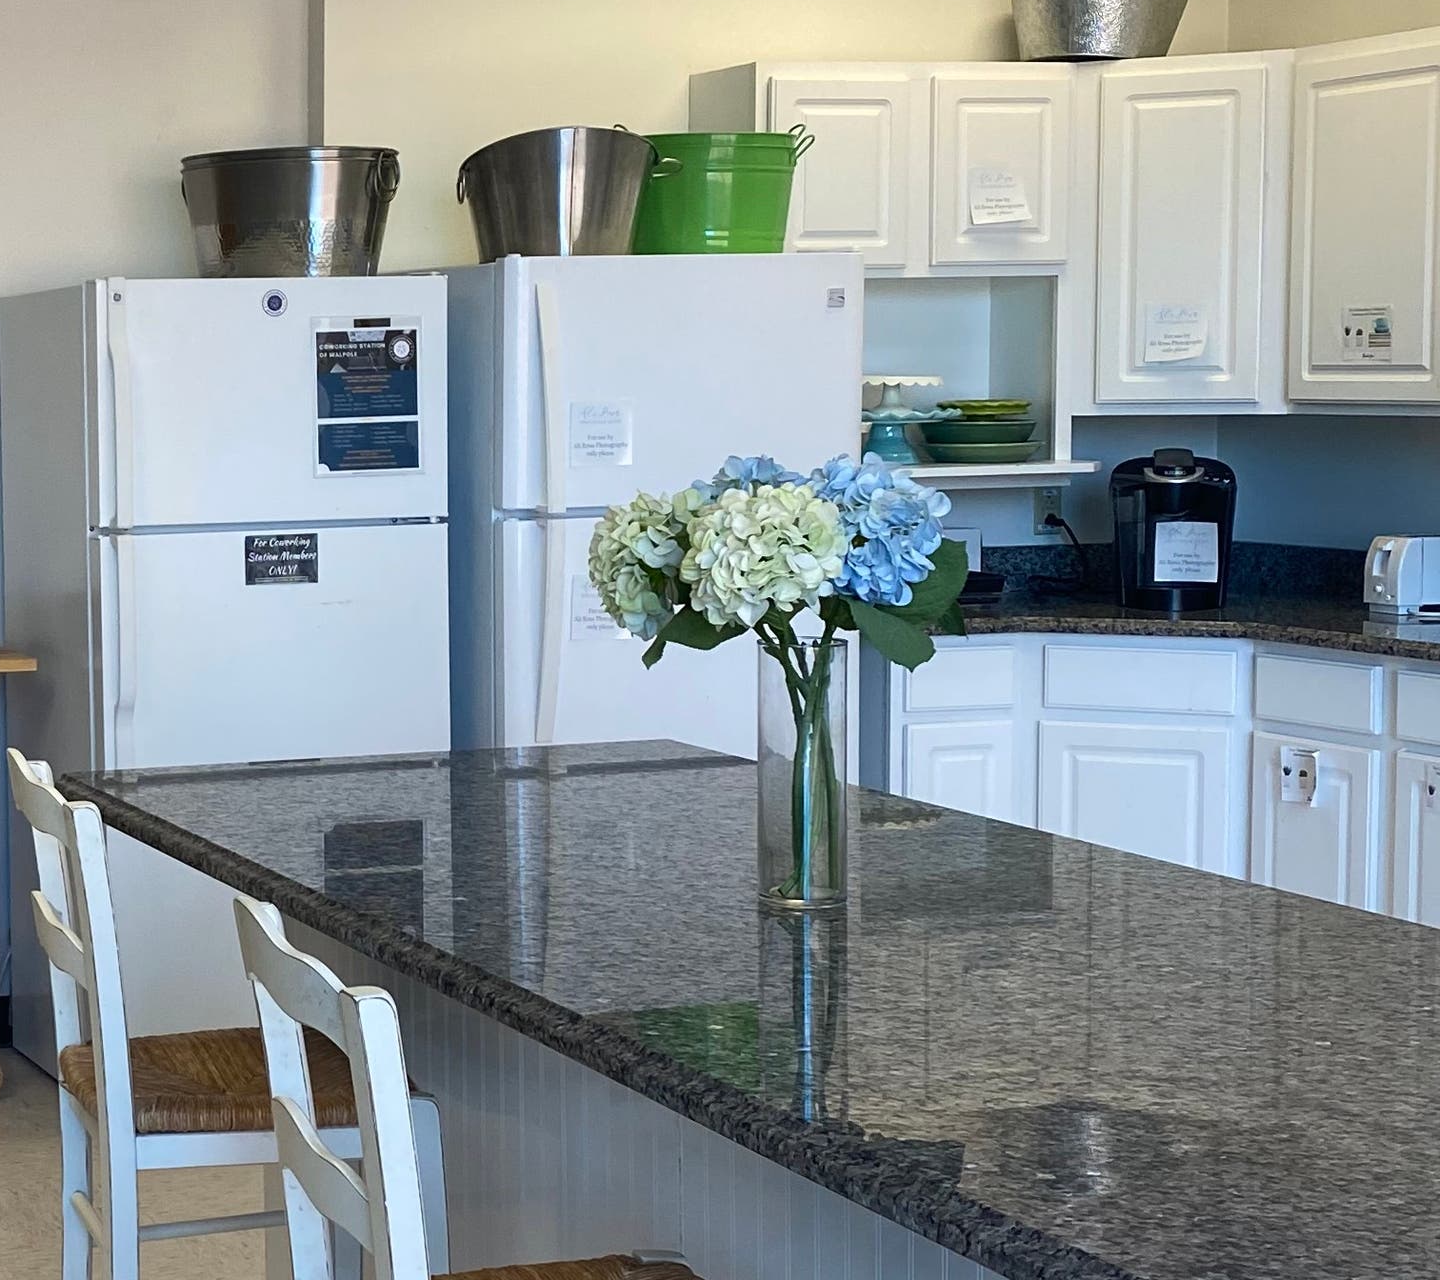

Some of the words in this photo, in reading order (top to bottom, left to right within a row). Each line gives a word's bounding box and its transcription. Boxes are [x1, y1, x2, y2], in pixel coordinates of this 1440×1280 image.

[319, 343, 358, 351] COWORKING
[359, 342, 386, 350] STATION
[253, 538, 267, 547] For
[269, 536, 311, 549] Coworking
[248, 551, 279, 562] Station
[280, 549, 317, 561] Members
